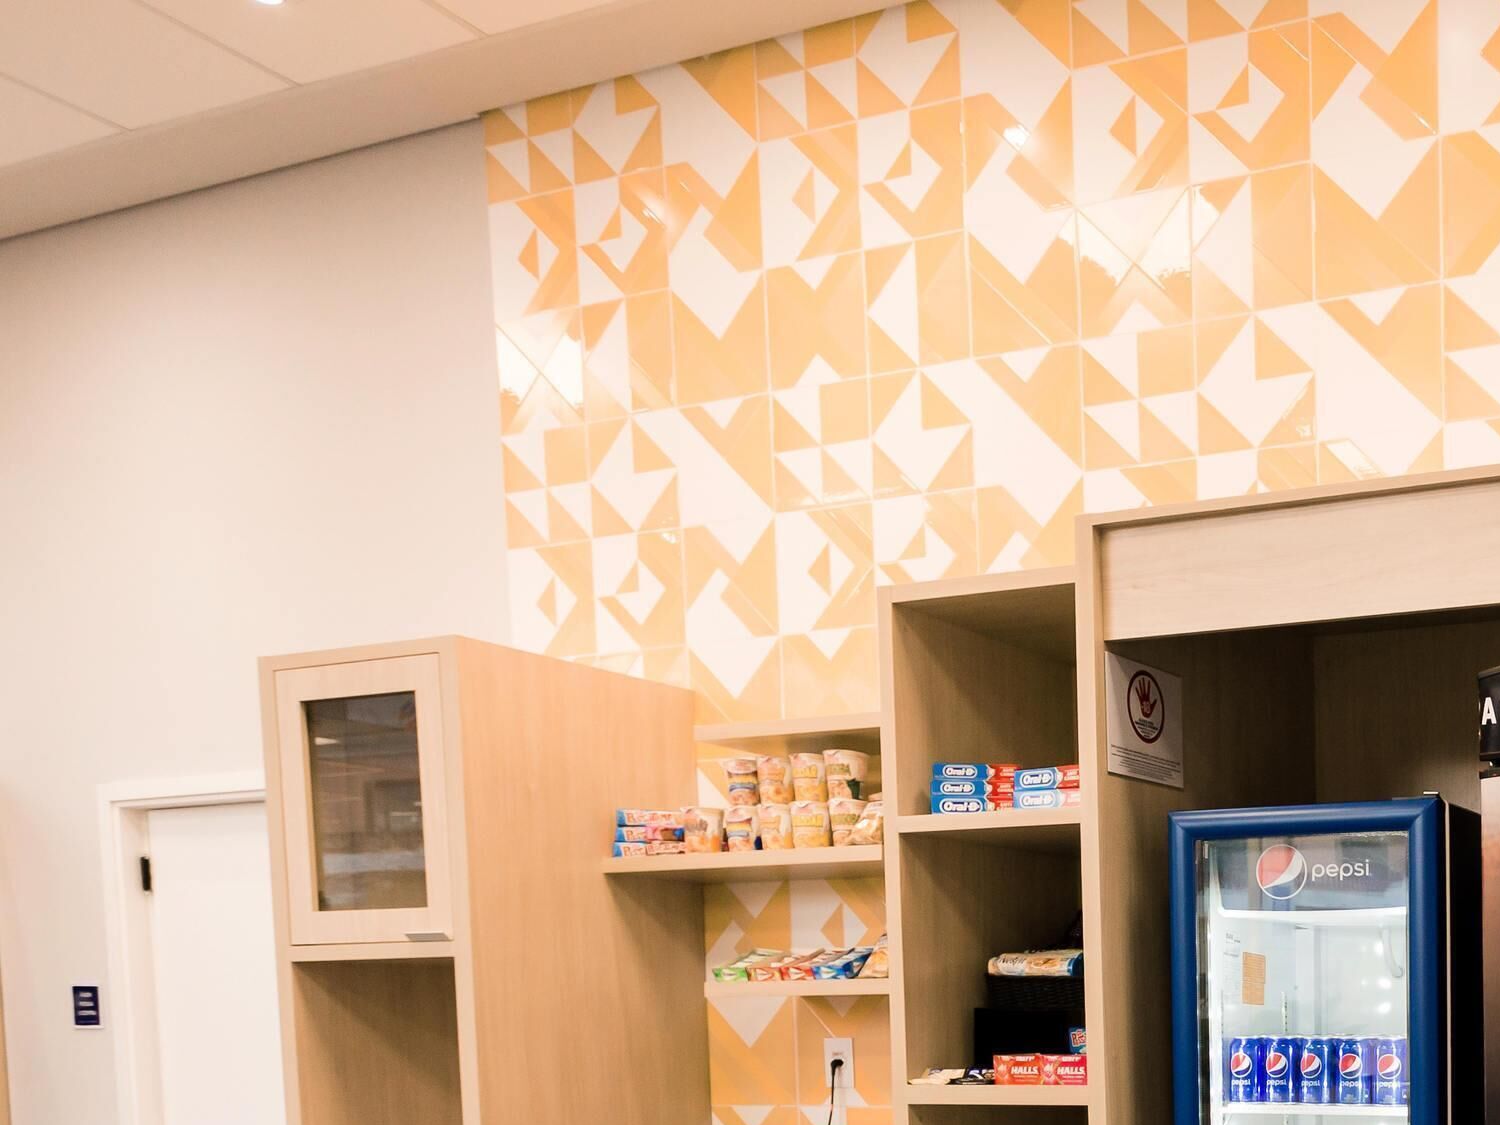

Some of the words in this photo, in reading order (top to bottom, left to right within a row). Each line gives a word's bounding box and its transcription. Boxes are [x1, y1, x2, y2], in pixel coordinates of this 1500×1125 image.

[1481, 697, 1497, 725] A
[1311, 860, 1370, 882] pepsi
[1010, 1066, 1039, 1075] HALLS
[1057, 1066, 1086, 1075] HALLS
